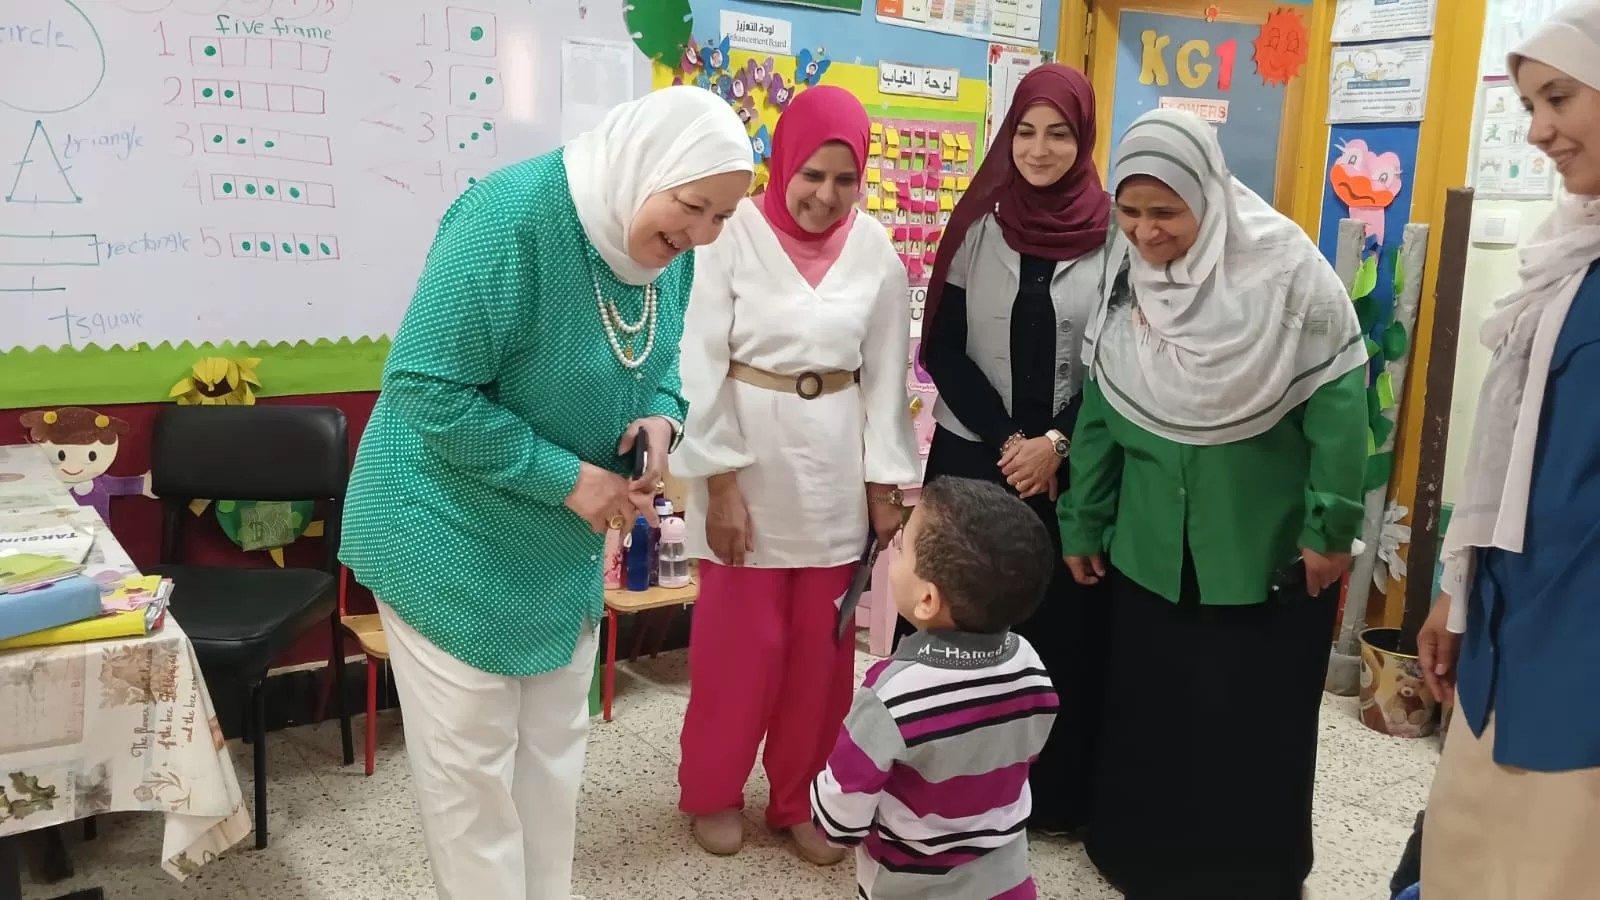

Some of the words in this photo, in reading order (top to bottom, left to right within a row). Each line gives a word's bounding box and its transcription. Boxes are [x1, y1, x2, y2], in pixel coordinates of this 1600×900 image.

[216, 14, 264, 35] five
[271, 17, 332, 40] frame
[416, 13, 432, 46] 1
[736, 20, 757, 32] التعزيز
[759, 24, 774, 36] لوحة
[154, 21, 175, 56] 1
[769, 39, 787, 48] Board
[414, 59, 434, 91] 2
[882, 69, 916, 88] الغياب
[924, 70, 952, 94] لوحة
[163, 76, 183, 105] 2
[417, 111, 435, 143] 3
[64, 125, 144, 160] triangle
[174, 121, 194, 157] 3
[182, 693, 197, 708] bee
[181, 710, 194, 725] the
[157, 725, 172, 740] the
[181, 726, 193, 742] and
[131, 736, 149, 758] The
[158, 740, 177, 750] of
